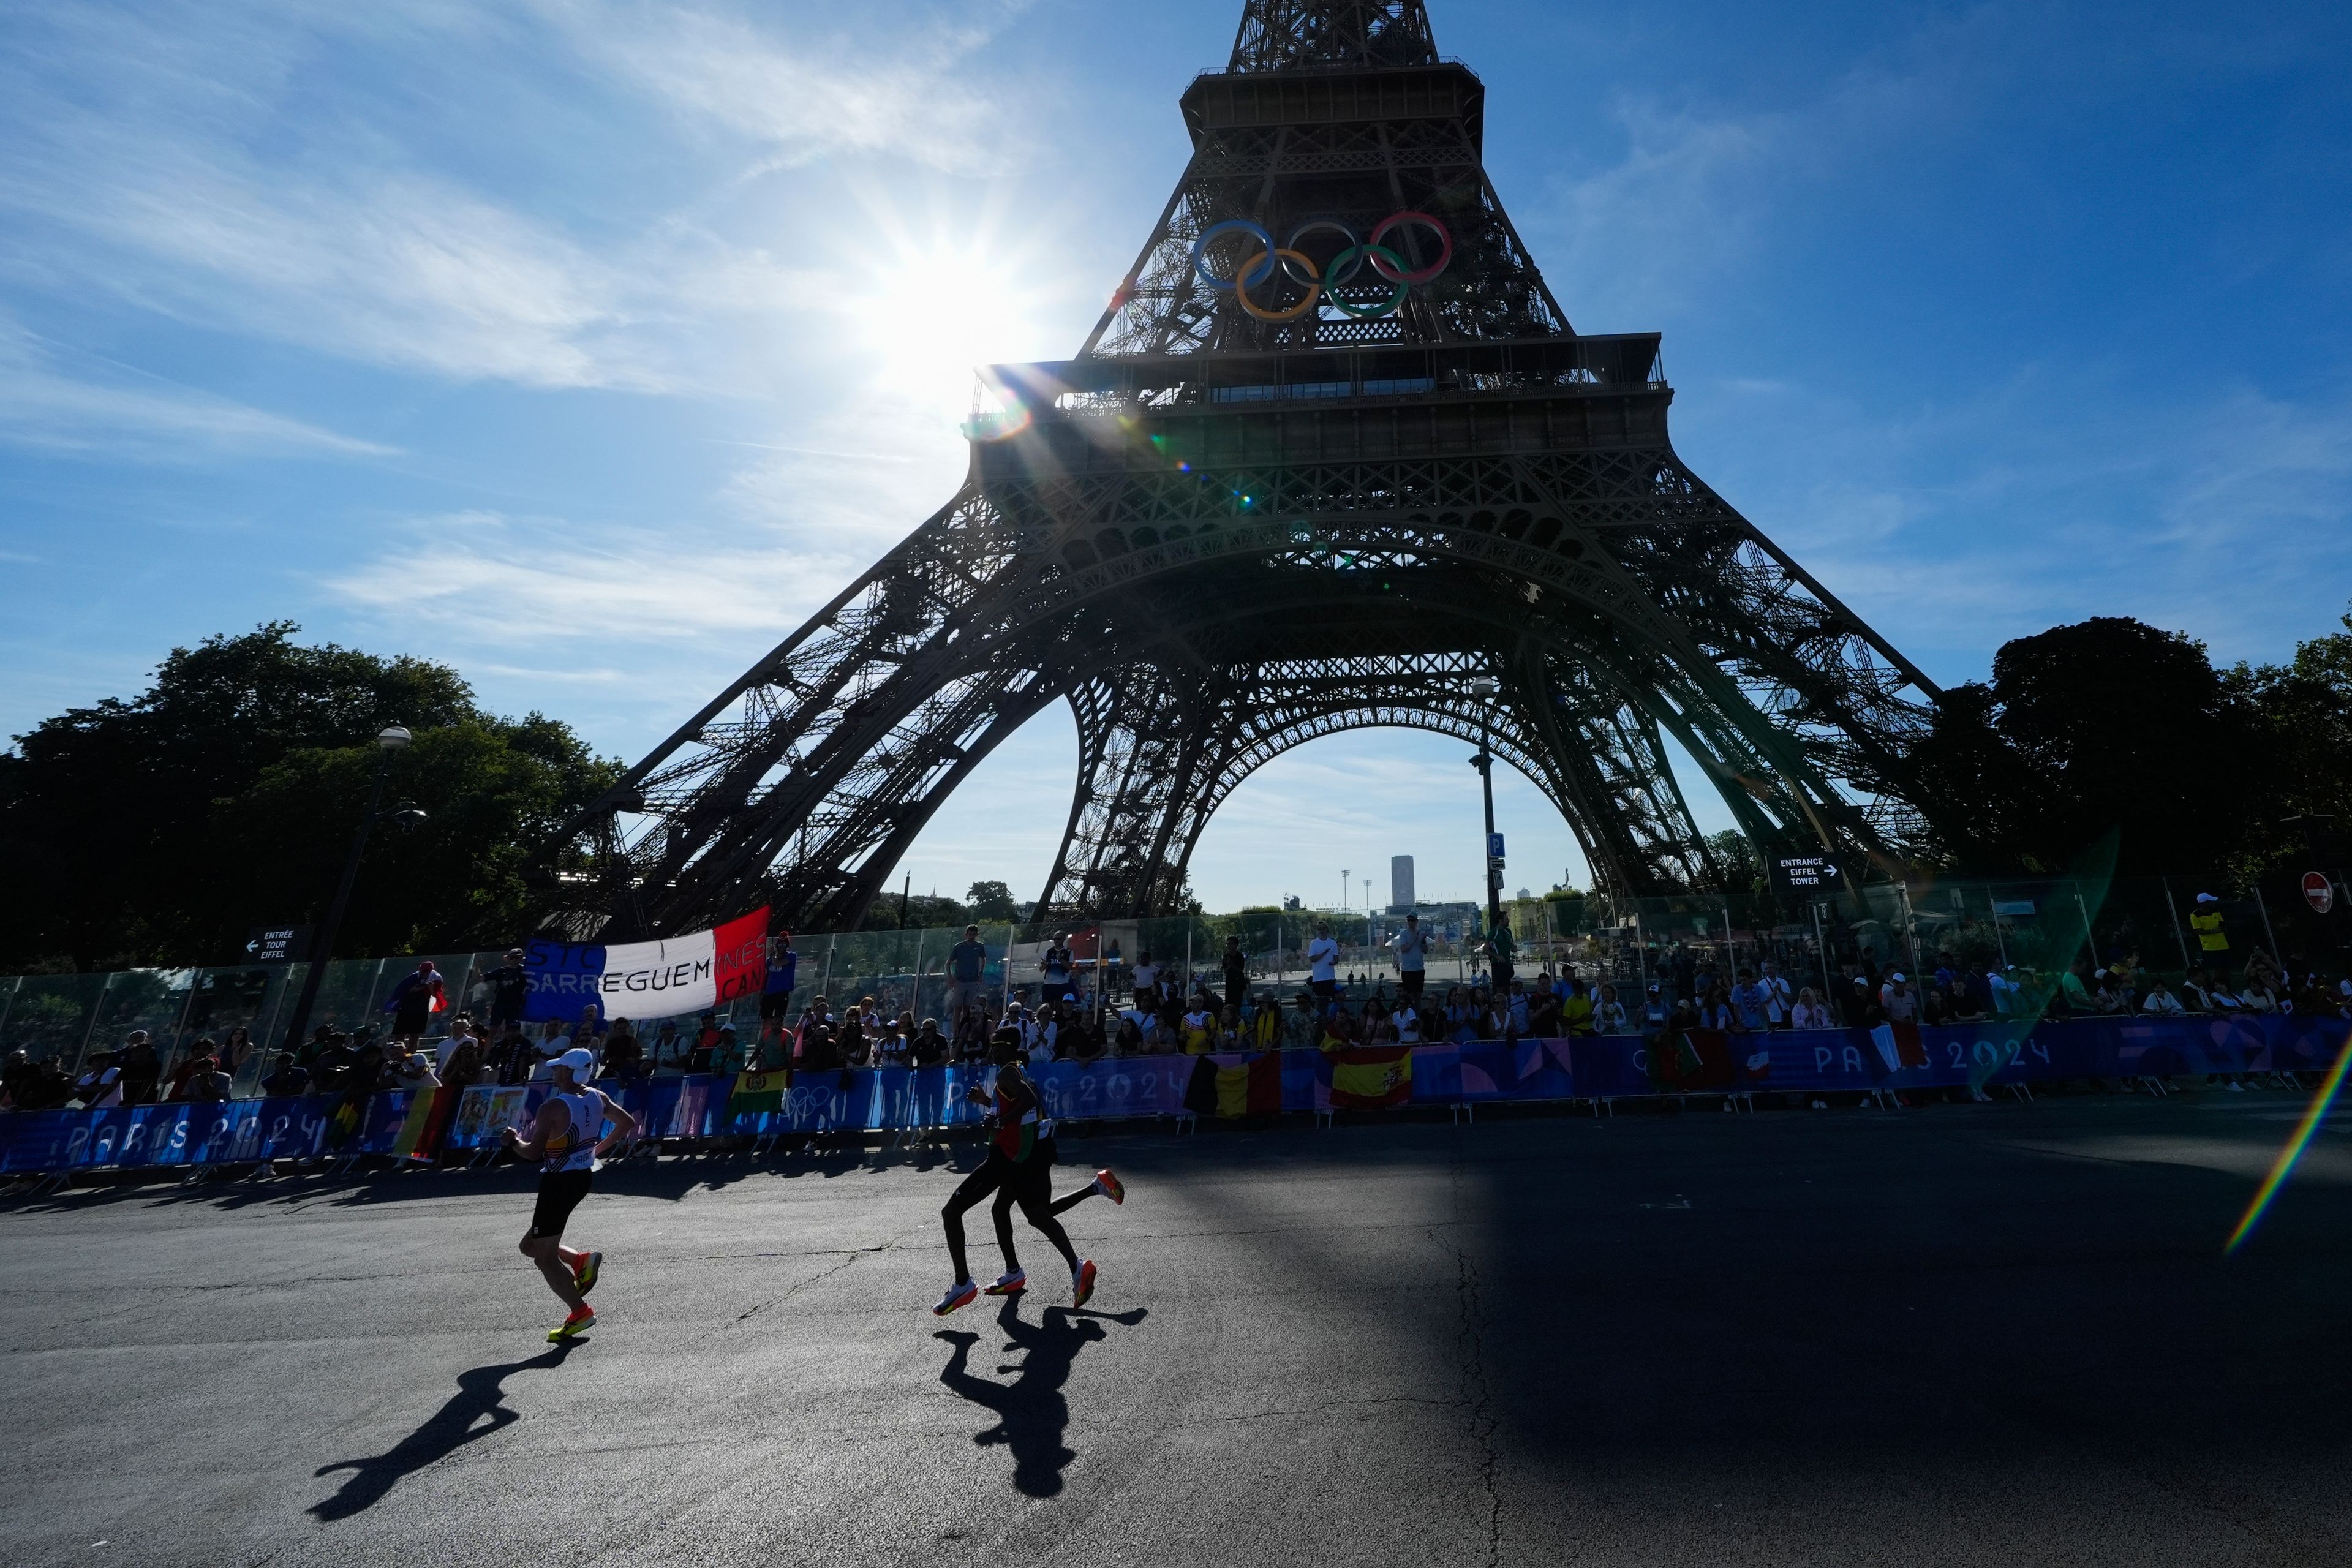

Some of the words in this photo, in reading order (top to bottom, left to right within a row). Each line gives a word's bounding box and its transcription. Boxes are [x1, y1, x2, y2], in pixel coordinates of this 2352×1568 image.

[1493, 838, 1500, 853] P
[1780, 858, 1824, 867] ENTRANCE
[1790, 877, 1819, 886] TOWER
[264, 929, 294, 940] ENTRÉE
[260, 950, 285, 959] EIFFEL
[526, 943, 600, 969] STC
[1947, 1038, 2051, 1068] 2024
[1079, 1071, 1186, 1101] 2024
[66, 1120, 191, 1155] PARIS
[206, 1113, 318, 1147] 2024
